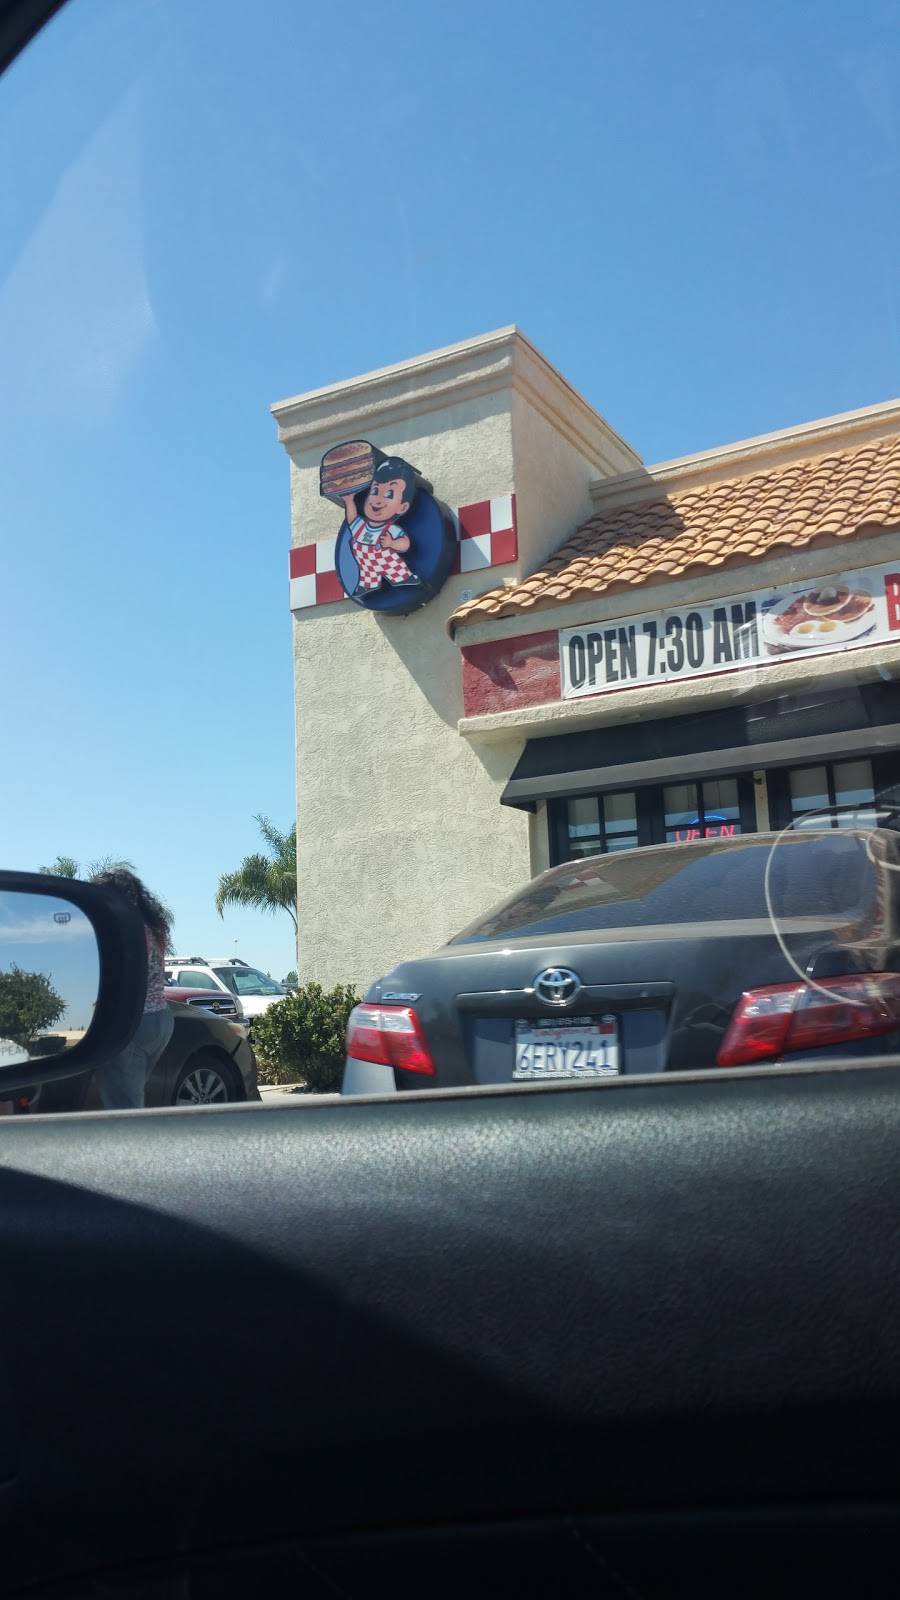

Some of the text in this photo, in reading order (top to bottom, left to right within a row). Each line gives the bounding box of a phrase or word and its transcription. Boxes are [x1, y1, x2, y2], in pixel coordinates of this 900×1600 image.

[569, 625, 637, 689] OPEN
[643, 612, 705, 676] 7:30
[713, 601, 760, 664] AM
[518, 1039, 611, 1071] 6ERY241
